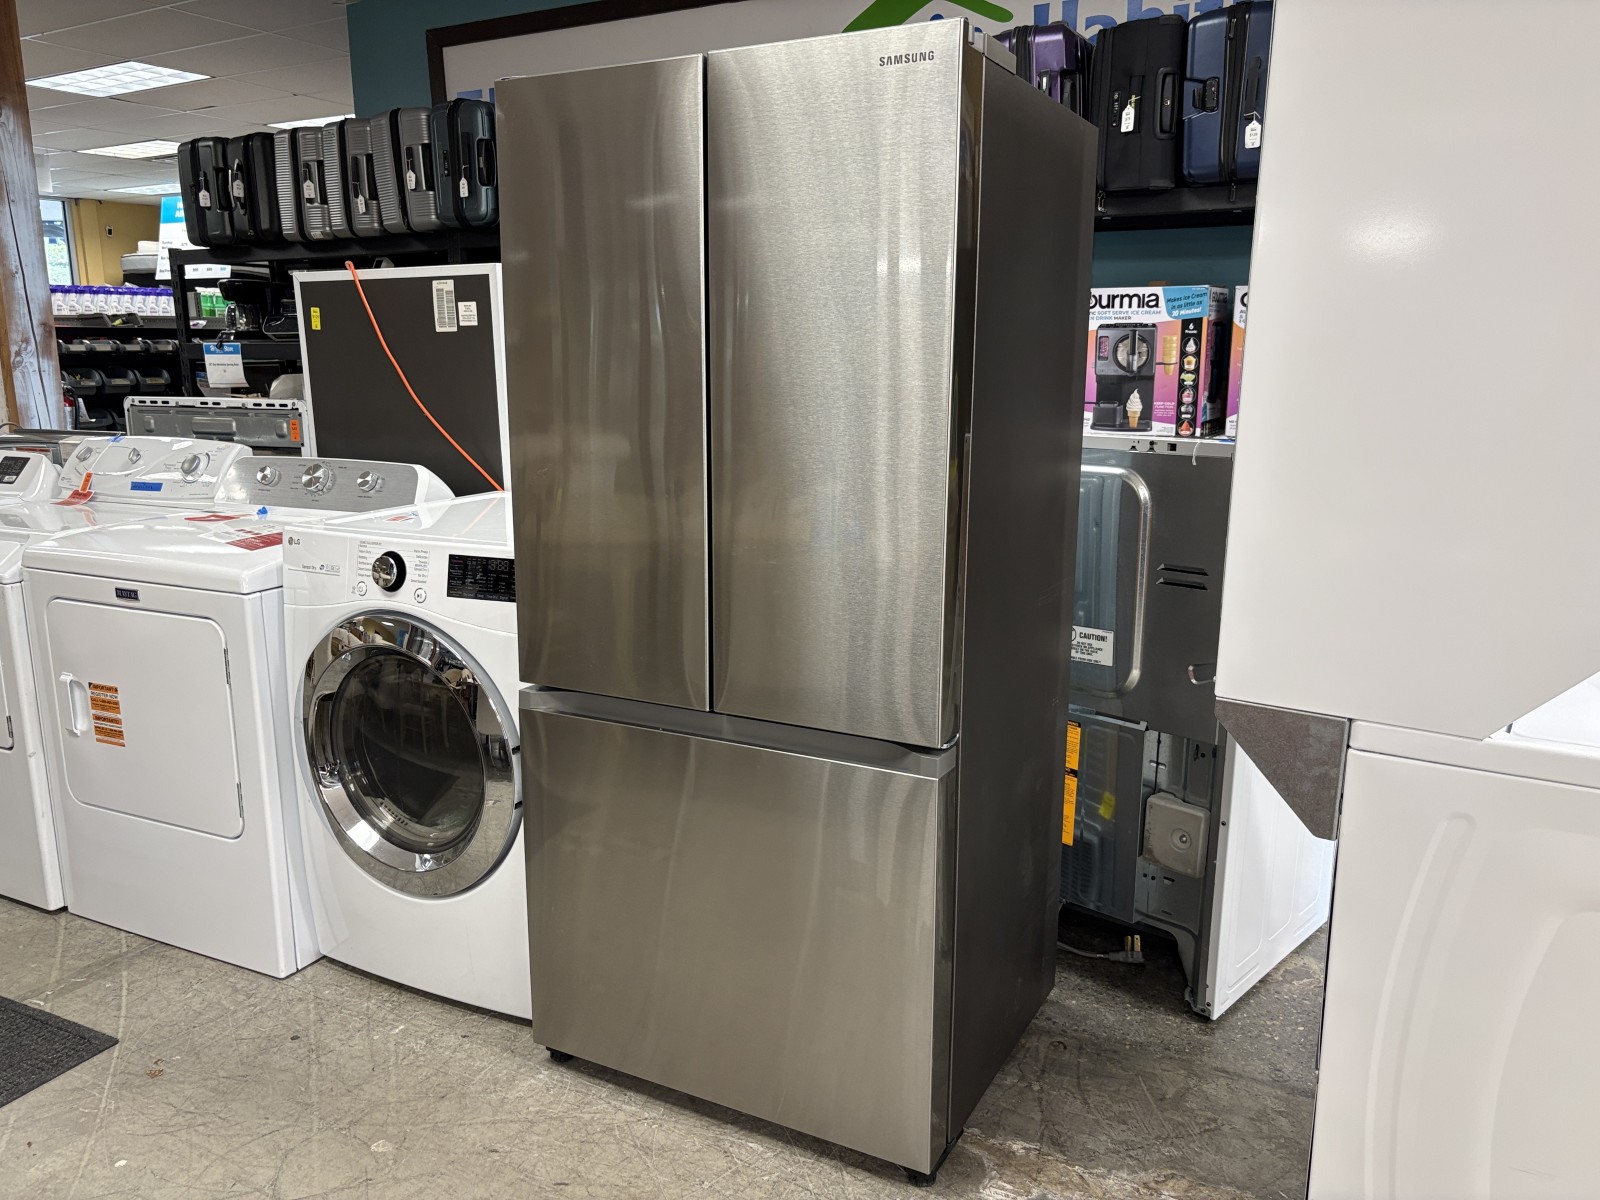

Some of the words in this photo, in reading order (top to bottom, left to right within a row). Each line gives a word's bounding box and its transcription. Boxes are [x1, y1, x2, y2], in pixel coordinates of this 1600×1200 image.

[879, 50, 935, 67] SAMSUNG
[1090, 292, 1160, 310] ourmia
[1180, 306, 1202, 316] Minutes!
[1079, 632, 1108, 642] CAUTION!
